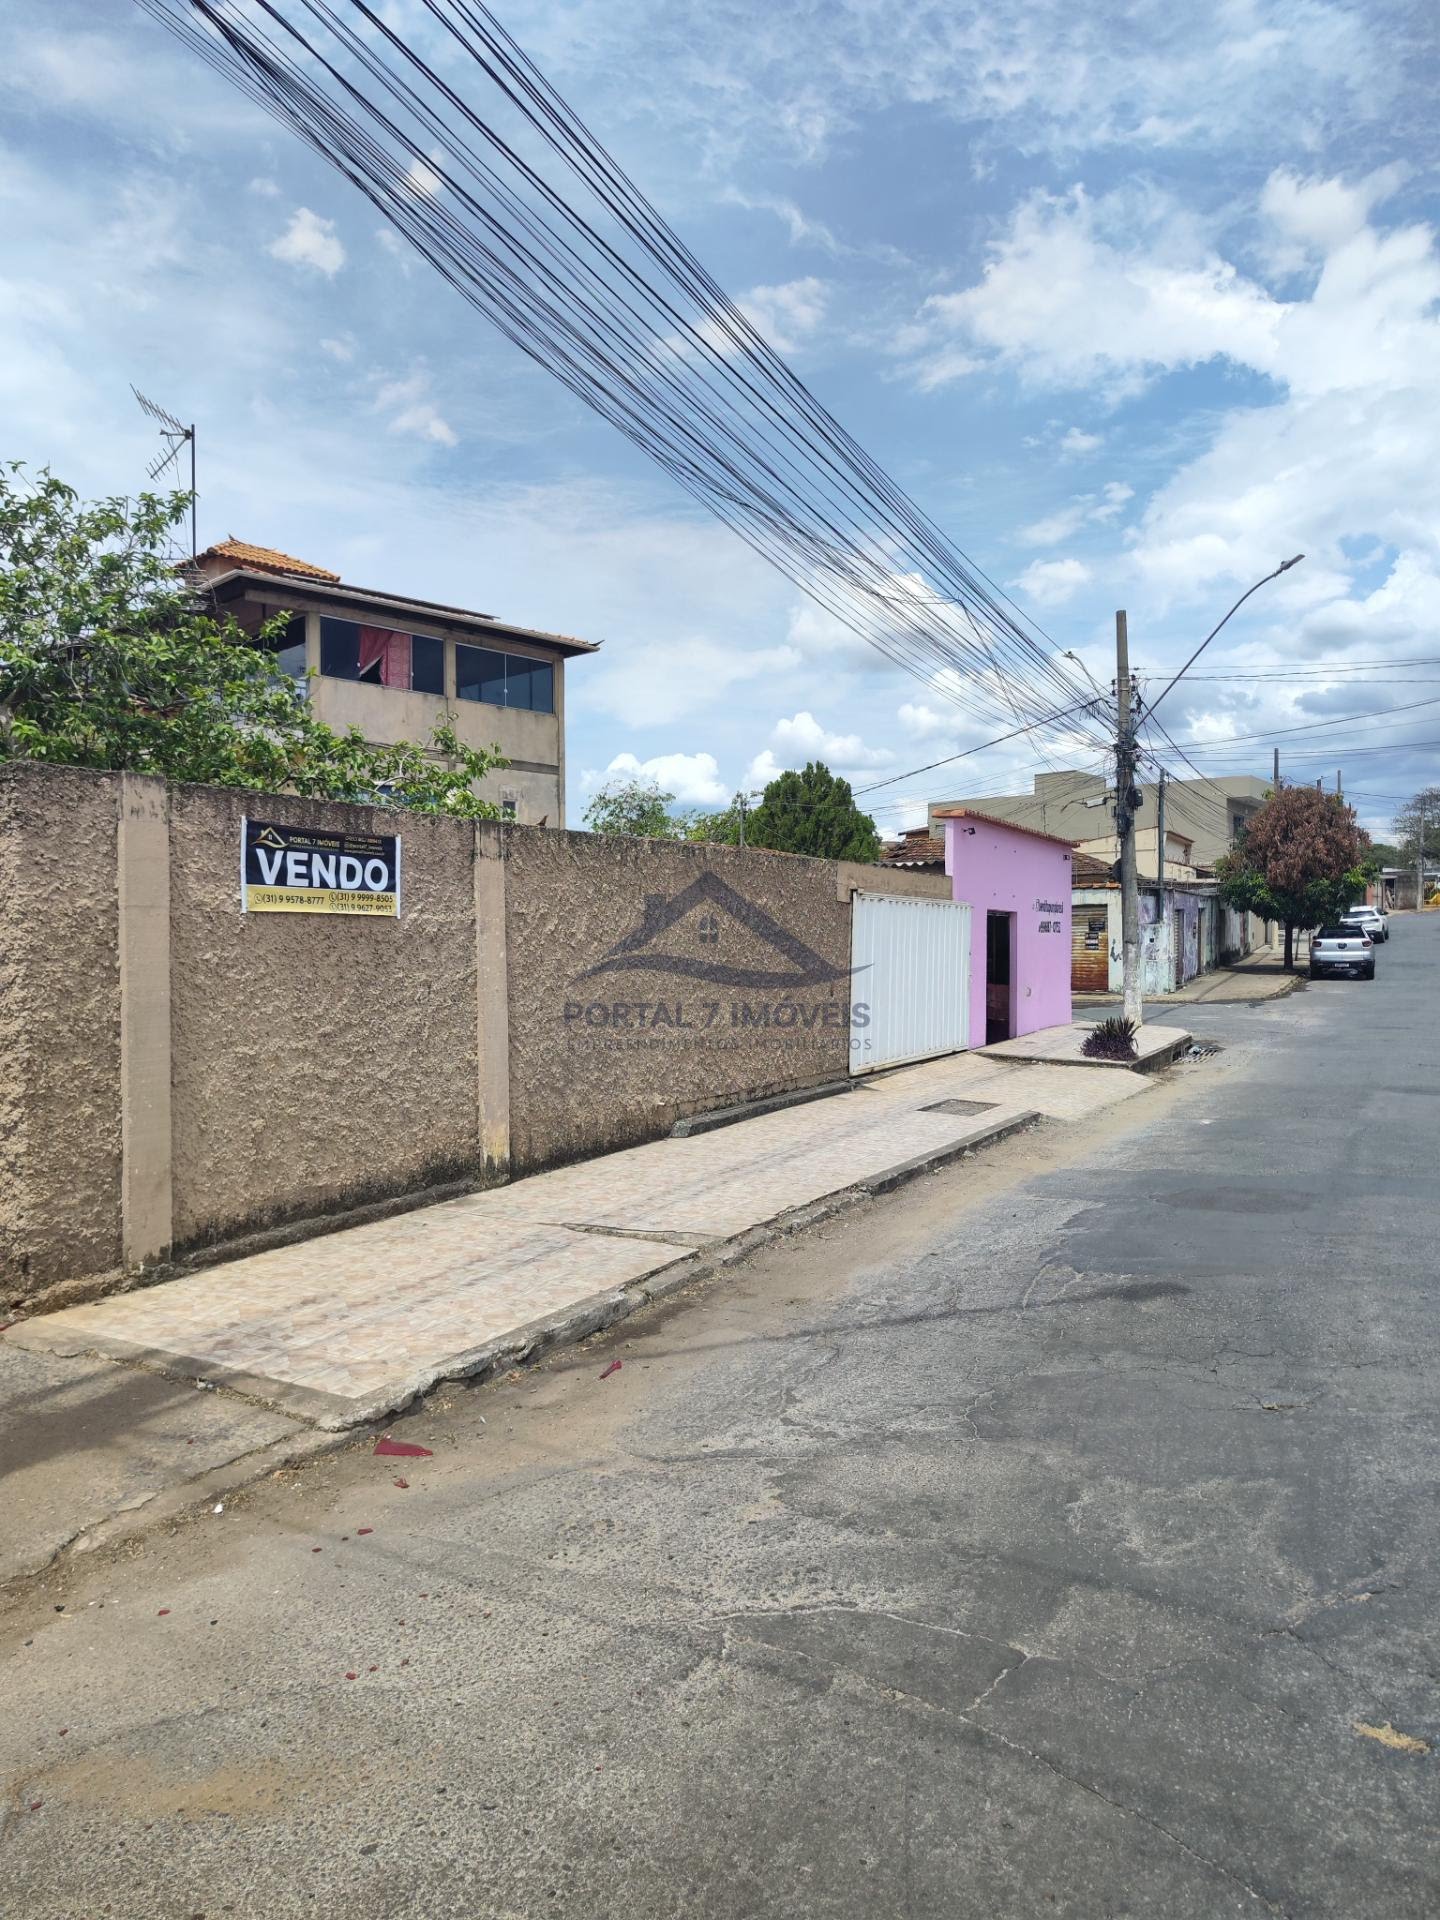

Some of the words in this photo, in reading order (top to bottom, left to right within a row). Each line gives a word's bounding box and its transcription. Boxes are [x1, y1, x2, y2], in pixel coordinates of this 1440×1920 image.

[289, 836, 312, 845] PORTAL
[256, 848, 389, 892] VENDO
[263, 893, 277, 905] (31)
[279, 895, 284, 904] 9
[286, 895, 325, 905] 9578-8777
[337, 892, 350, 902] (31)
[351, 893, 356, 901] 9
[357, 893, 393, 903] 9999-8505
[337, 902, 350, 912] (31)
[351, 903, 356, 911] 9
